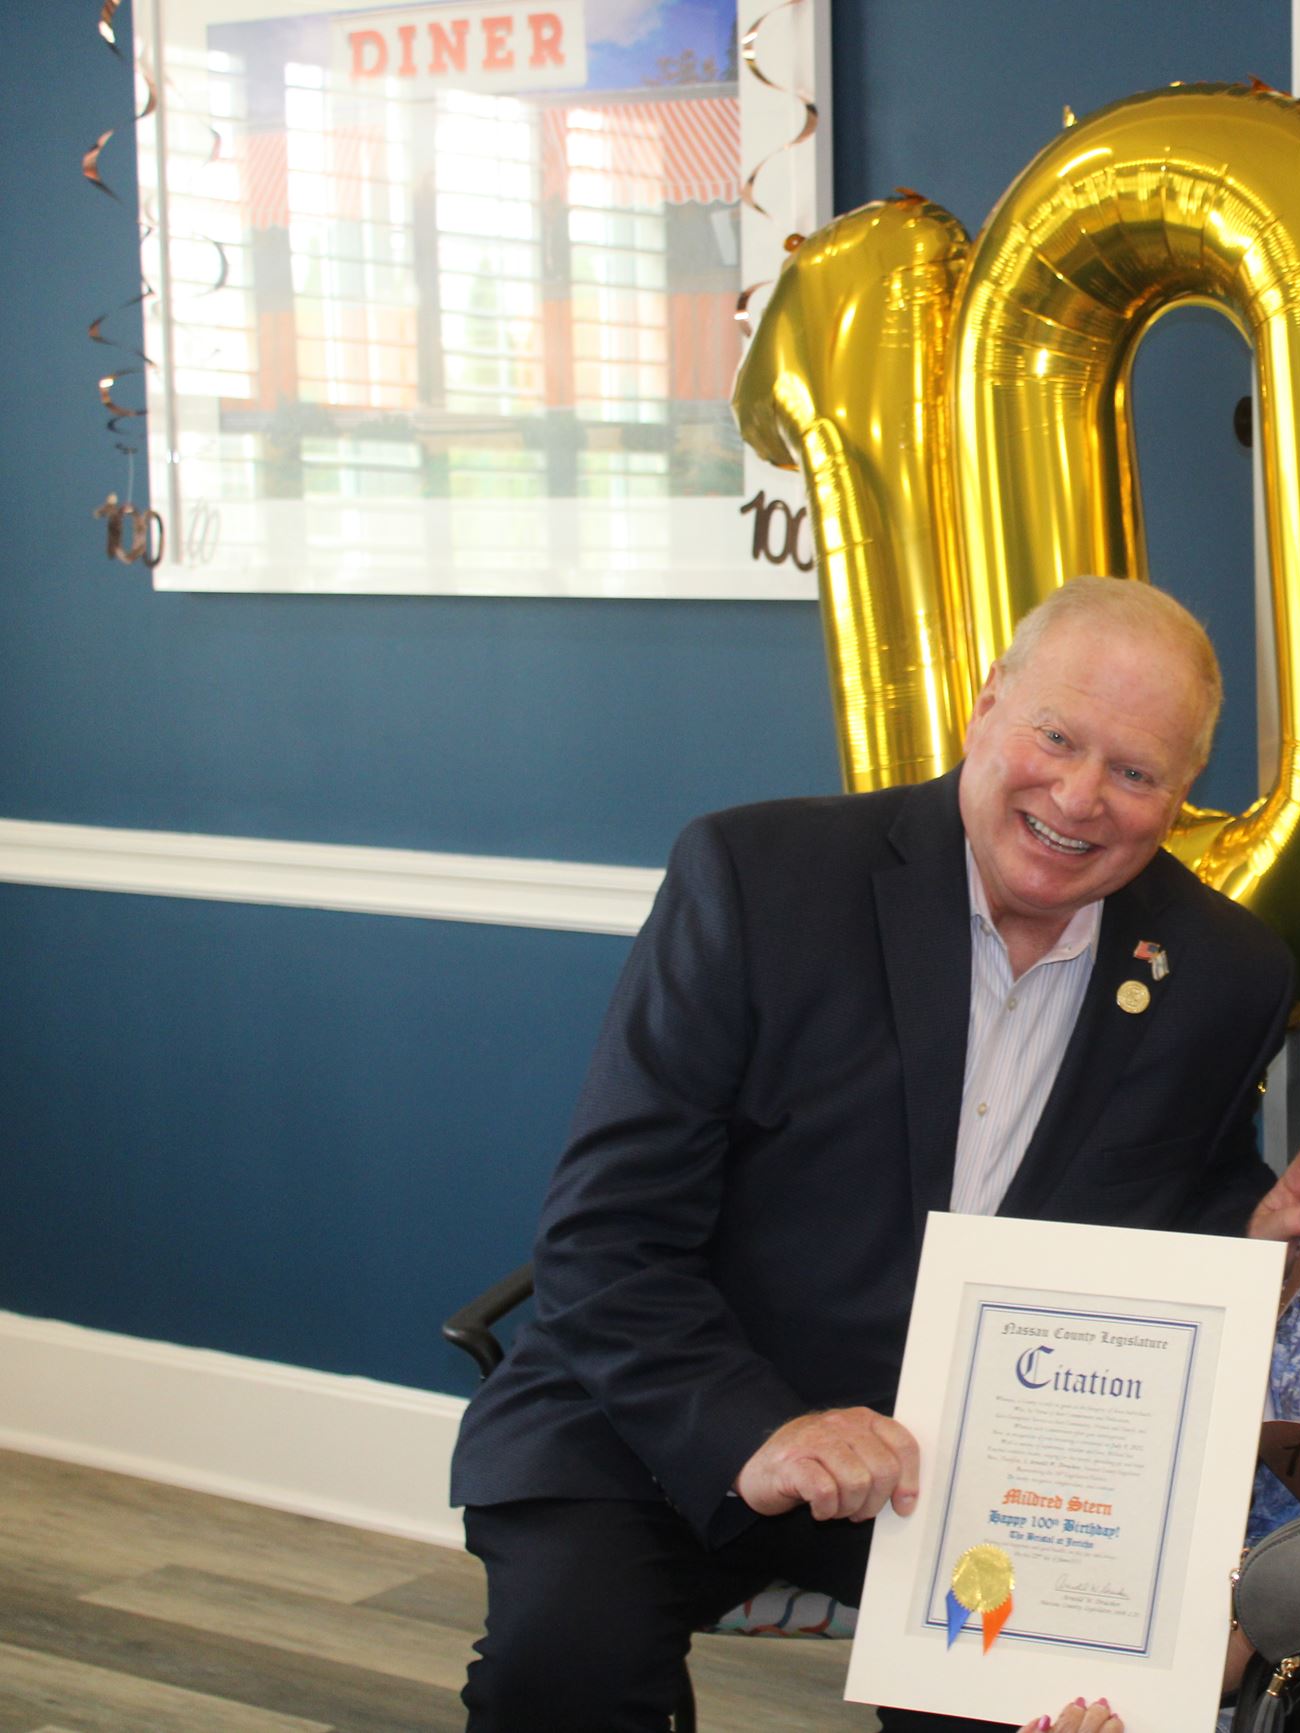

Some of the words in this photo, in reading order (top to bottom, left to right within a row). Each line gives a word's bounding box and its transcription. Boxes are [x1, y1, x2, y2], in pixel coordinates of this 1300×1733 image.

[349, 11, 566, 81] DINER
[1053, 1327, 1097, 1344] County
[1100, 1330, 1169, 1350] Legislature
[1015, 1345, 1144, 1400] Citation
[1002, 1488, 1063, 1510] Mildred
[1066, 1496, 1113, 1516] Stern
